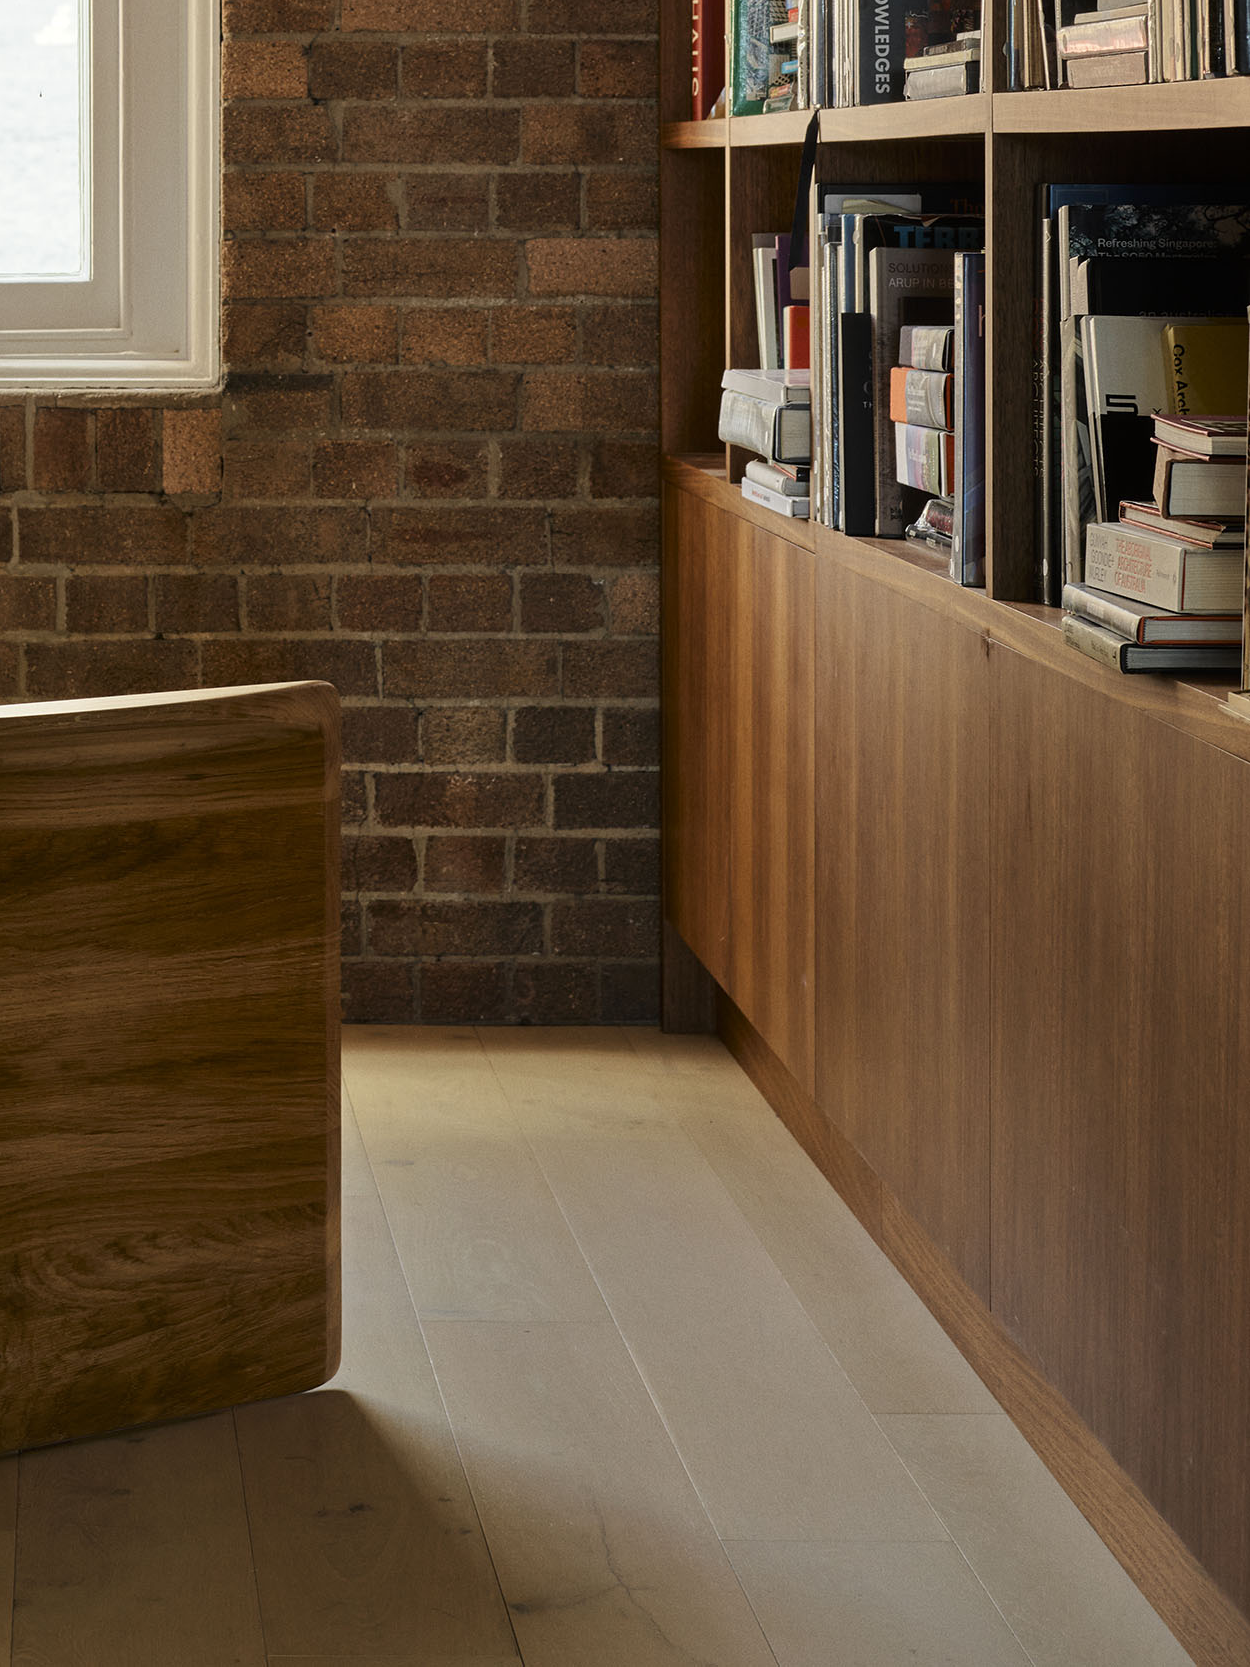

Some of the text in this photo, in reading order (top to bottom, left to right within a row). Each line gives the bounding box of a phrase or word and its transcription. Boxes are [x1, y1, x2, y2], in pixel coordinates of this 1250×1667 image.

[1097, 238, 1157, 251] Refreshing
[888, 277, 919, 288] ARUP
[923, 277, 935, 289] IN
[1173, 344, 1185, 376] Cox
